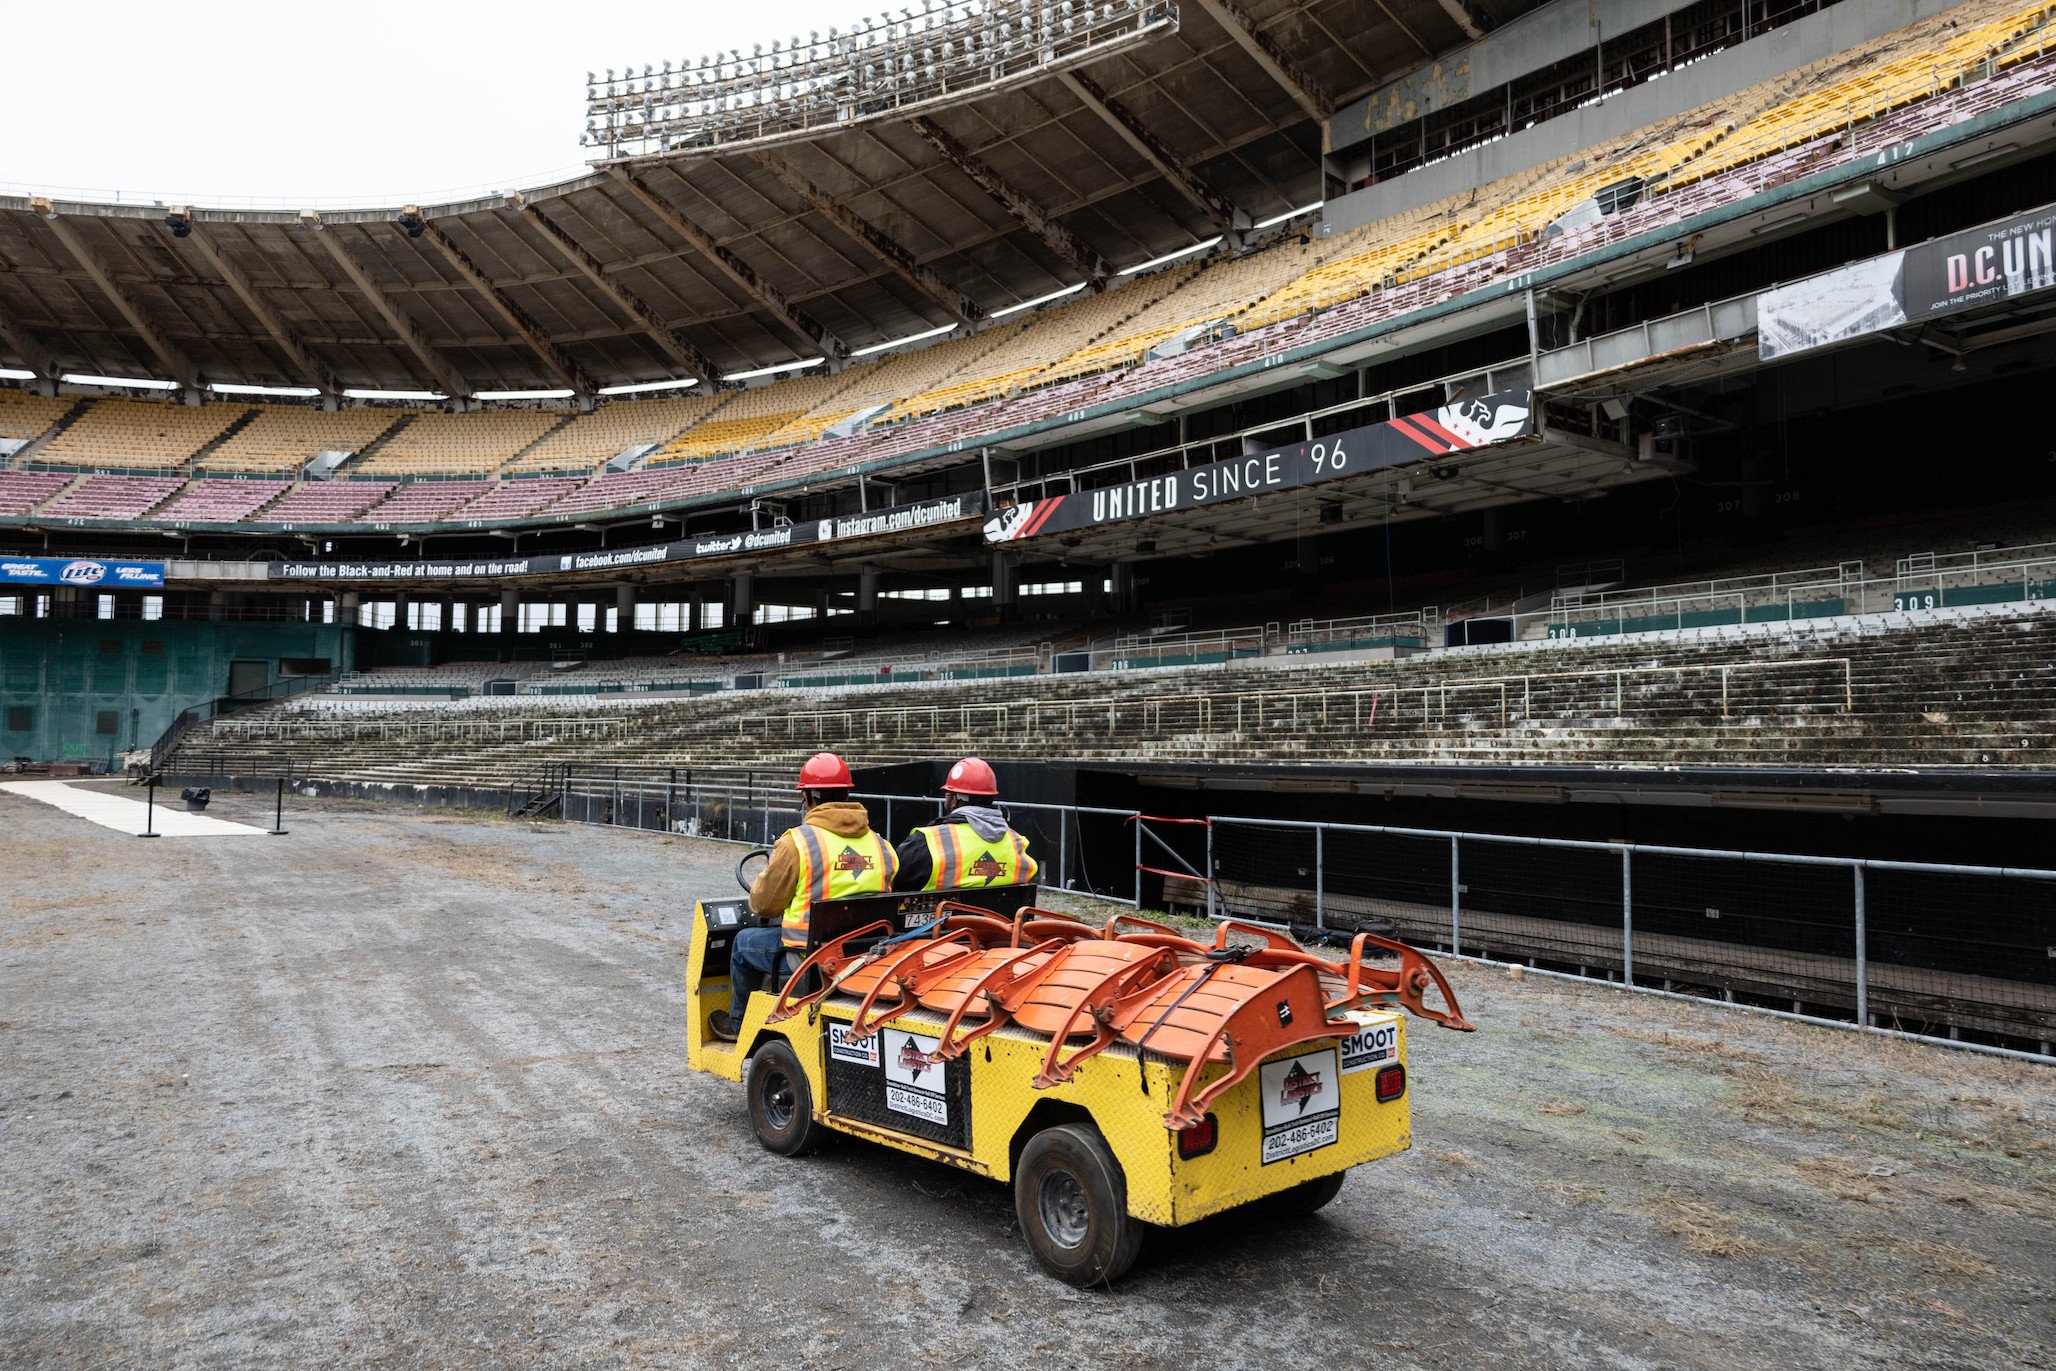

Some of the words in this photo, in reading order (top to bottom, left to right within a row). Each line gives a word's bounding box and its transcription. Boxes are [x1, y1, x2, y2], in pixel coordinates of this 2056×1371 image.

[1987, 230, 2007, 242] THE
[2009, 221, 2034, 236] NEW
[1507, 274, 1531, 290] 411
[1930, 299, 1948, 310] JOIN
[1949, 295, 1965, 306] THE
[1965, 284, 2001, 300] PRIORITY
[1264, 353, 1283, 368] 410
[1068, 410, 1085, 422] 409
[1093, 475, 1178, 522] UNITED
[1192, 453, 1281, 501] SINCE
[1716, 499, 1741, 513] 307
[836, 497, 961, 538] instagram.com/dcunited
[696, 540, 731, 554] twitter
[744, 528, 792, 548] @dcunited
[1, 563, 38, 571] GREAT
[575, 546, 668, 568] facebook.com/dcunited
[116, 566, 143, 574] LESS
[283, 564, 317, 577] Follow
[319, 564, 336, 576] the
[339, 564, 412, 577] Black-and-Red
[414, 564, 425, 576] at
[427, 563, 453, 576] home
[454, 562, 473, 575] and
[474, 565, 485, 575] on
[485, 562, 503, 574] the
[504, 560, 528, 573] road!
[1894, 595, 1934, 613] 309
[1549, 627, 1577, 640] 308
[2021, 738, 2029, 748] 9
[1341, 1026, 1396, 1056] SMOOT
[889, 1101, 946, 1123] DistrictLogisticsDC.com
[890, 1089, 943, 1114] 202-486-6402
[1268, 1120, 1334, 1150] 202-486-6402
[1265, 1134, 1334, 1160] DistrictLogisticsDC.com
